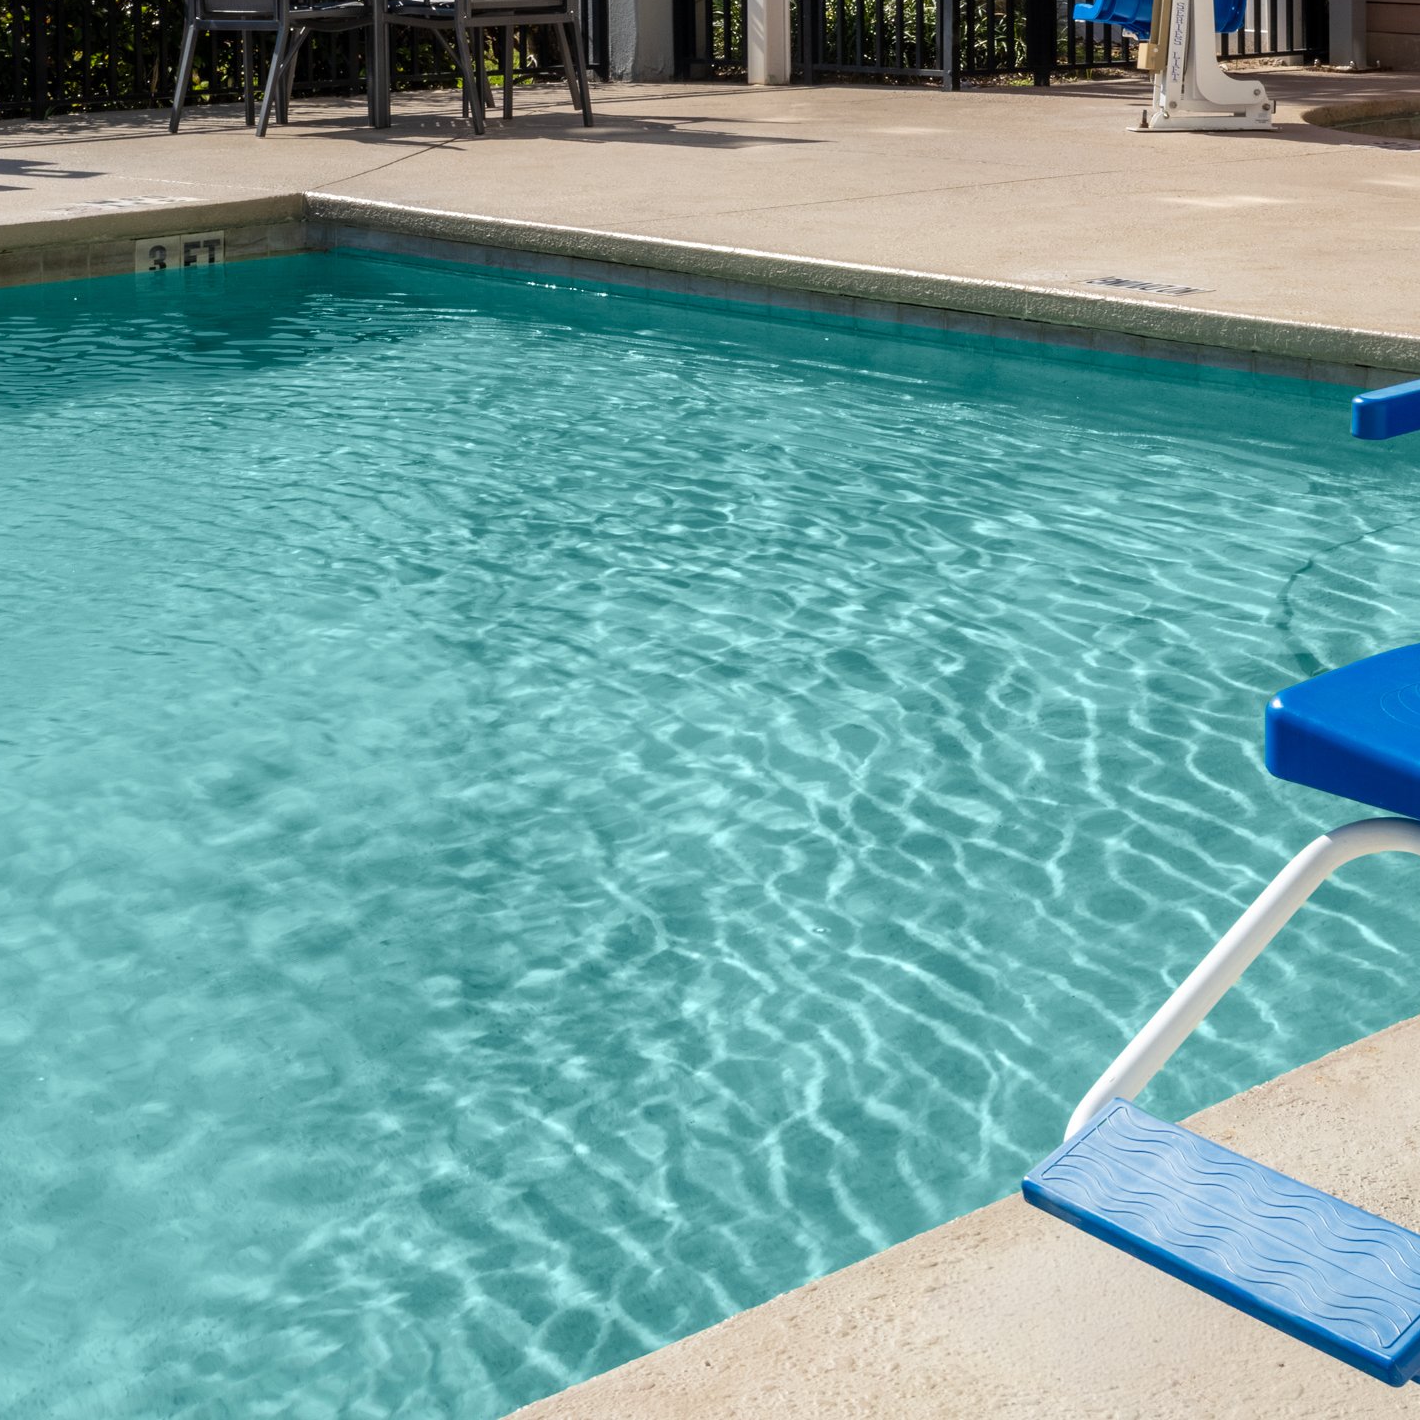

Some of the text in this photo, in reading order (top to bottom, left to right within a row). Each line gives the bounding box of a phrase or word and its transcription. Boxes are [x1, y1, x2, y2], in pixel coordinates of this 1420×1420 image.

[1174, 2, 1185, 46] SERIES
[148, 238, 221, 271] 3 FT
